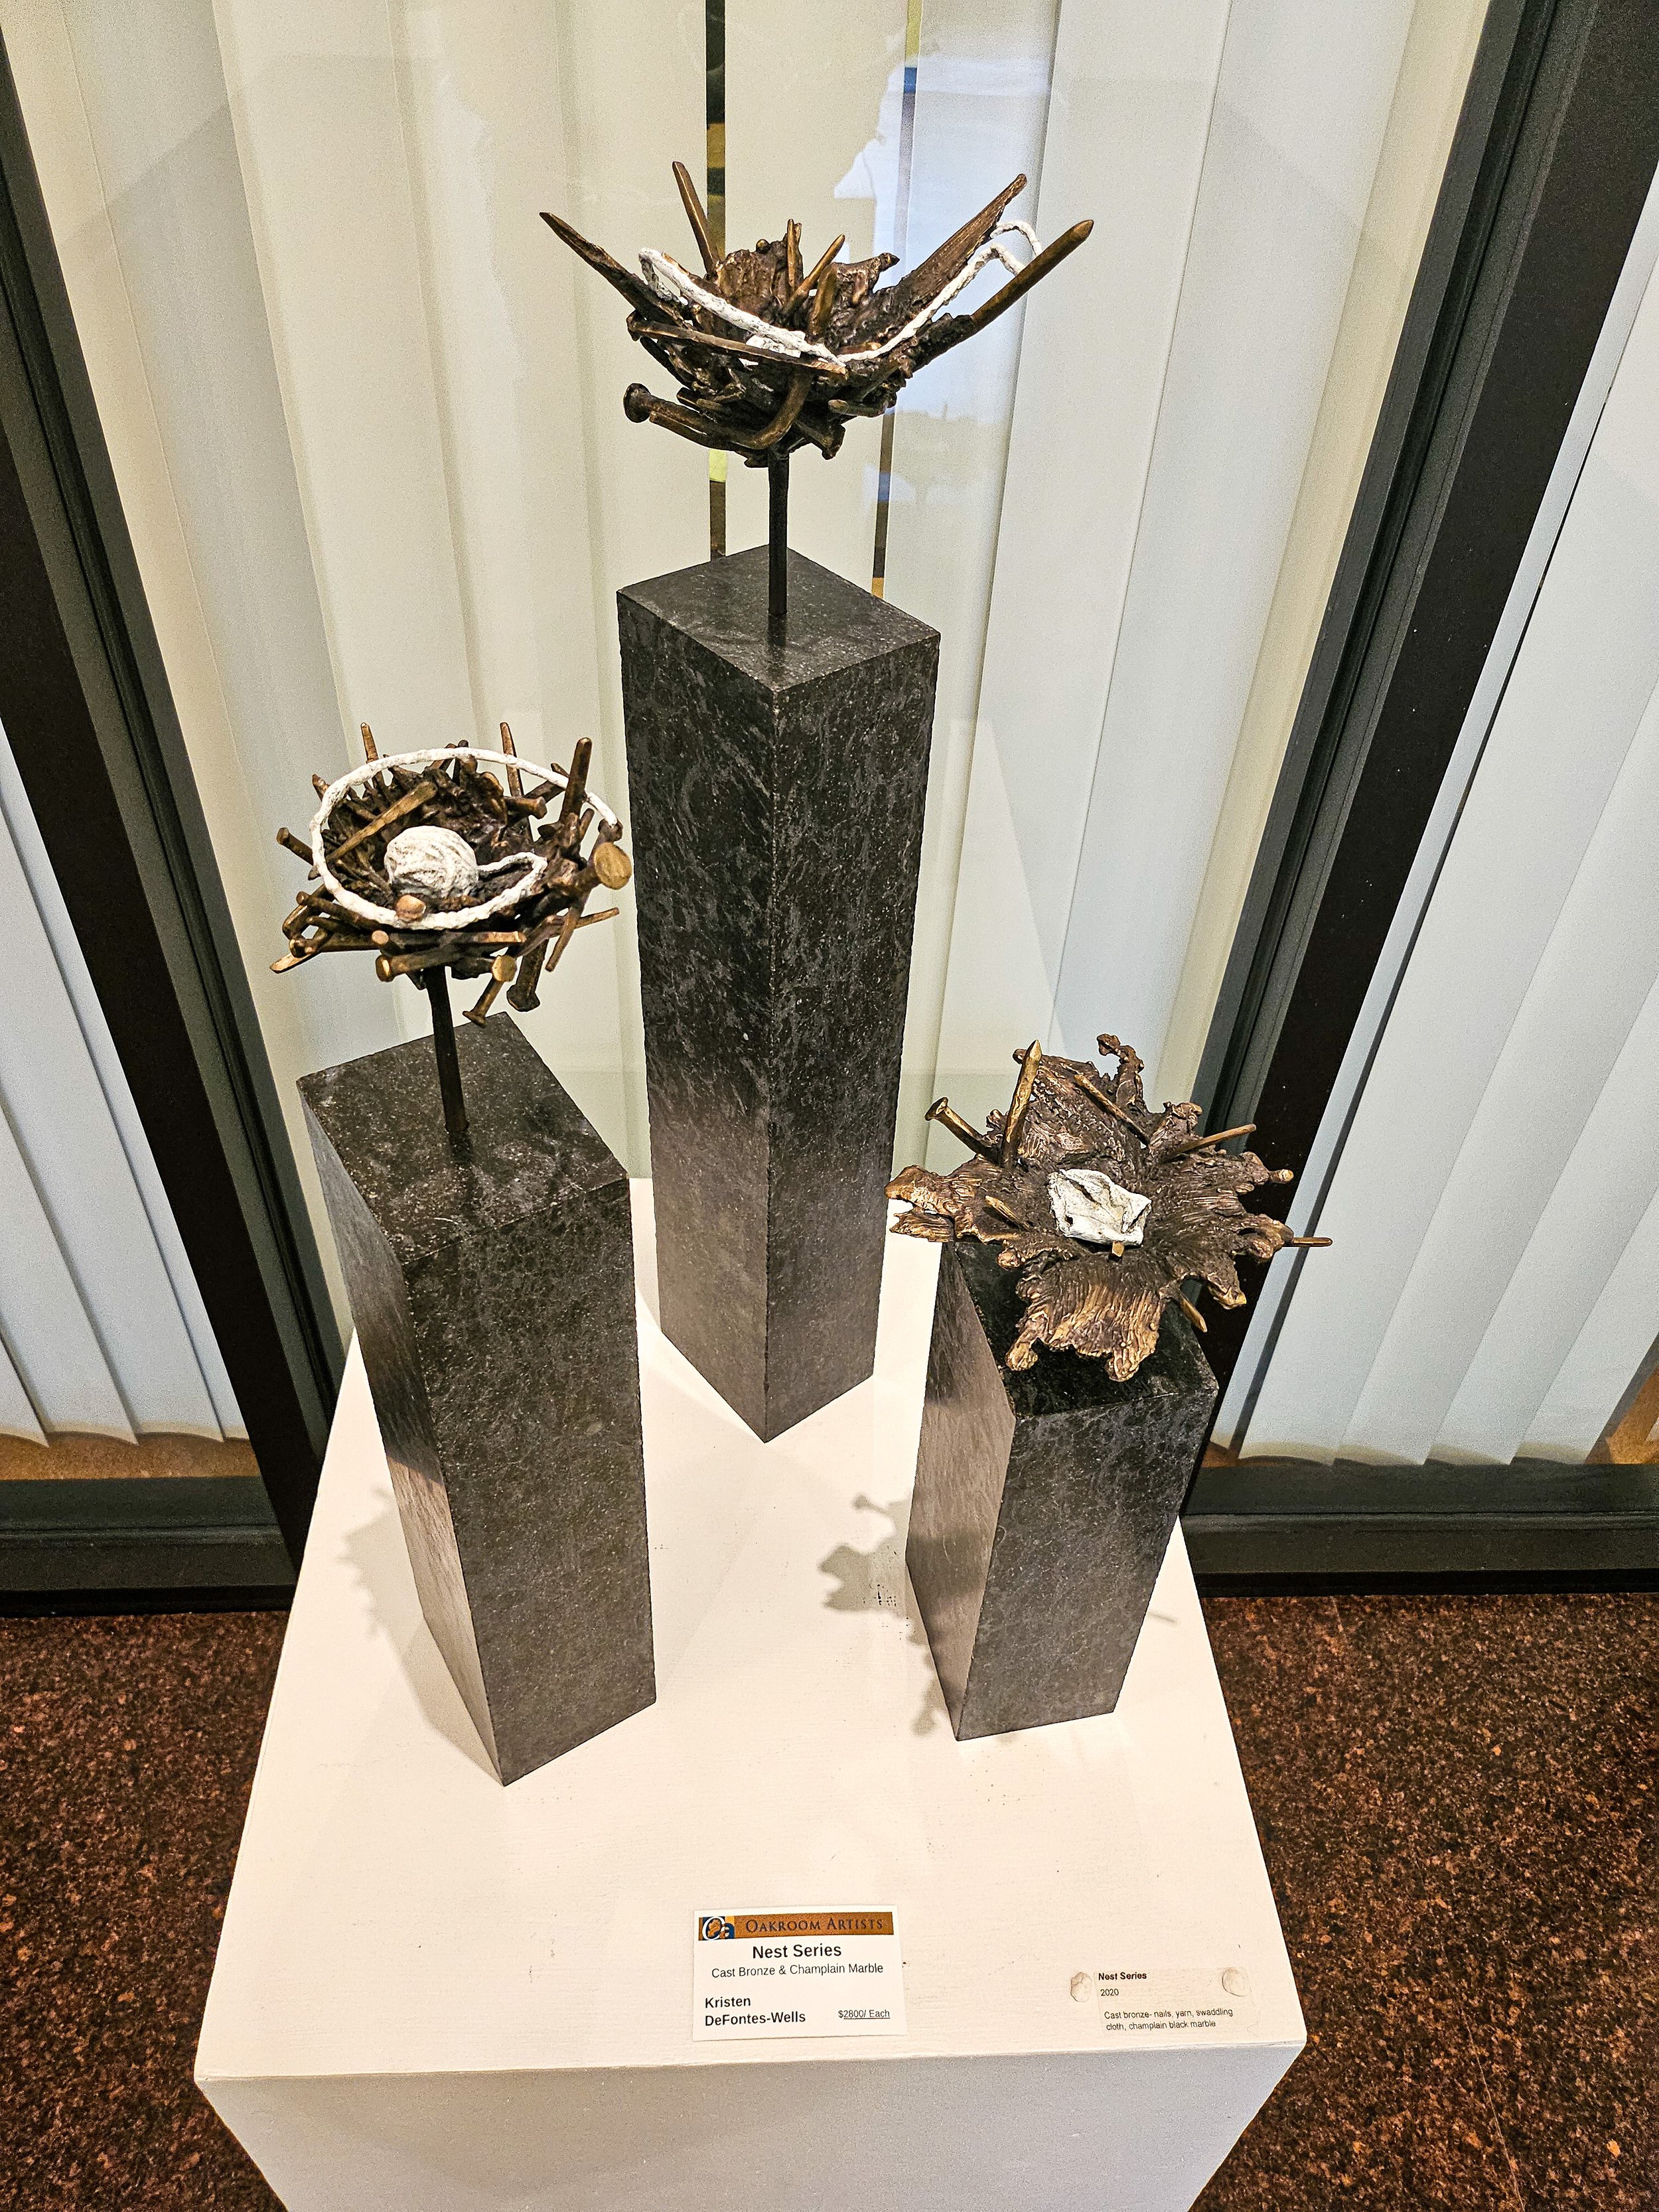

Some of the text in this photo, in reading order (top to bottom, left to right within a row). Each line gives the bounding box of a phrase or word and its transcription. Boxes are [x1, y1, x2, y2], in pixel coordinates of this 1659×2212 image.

[753, 1943, 842, 1958] Nest Series
[711, 1962, 884, 1978] Cast Bronze & Champlain Marble
[1098, 1972, 1147, 1981] Nest Series
[705, 1996, 751, 2008] Kristen
[705, 2012, 806, 2026] DeFontes-Wells
[838, 2009, 891, 2019] $2800/ Each
[1123, 2010, 1152, 2019] bronze-
[1154, 2010, 1174, 2018] nails,
[1196, 2008, 1234, 2017] swaddling
[1106, 2020, 1216, 2031] cloth, champlain black marble
